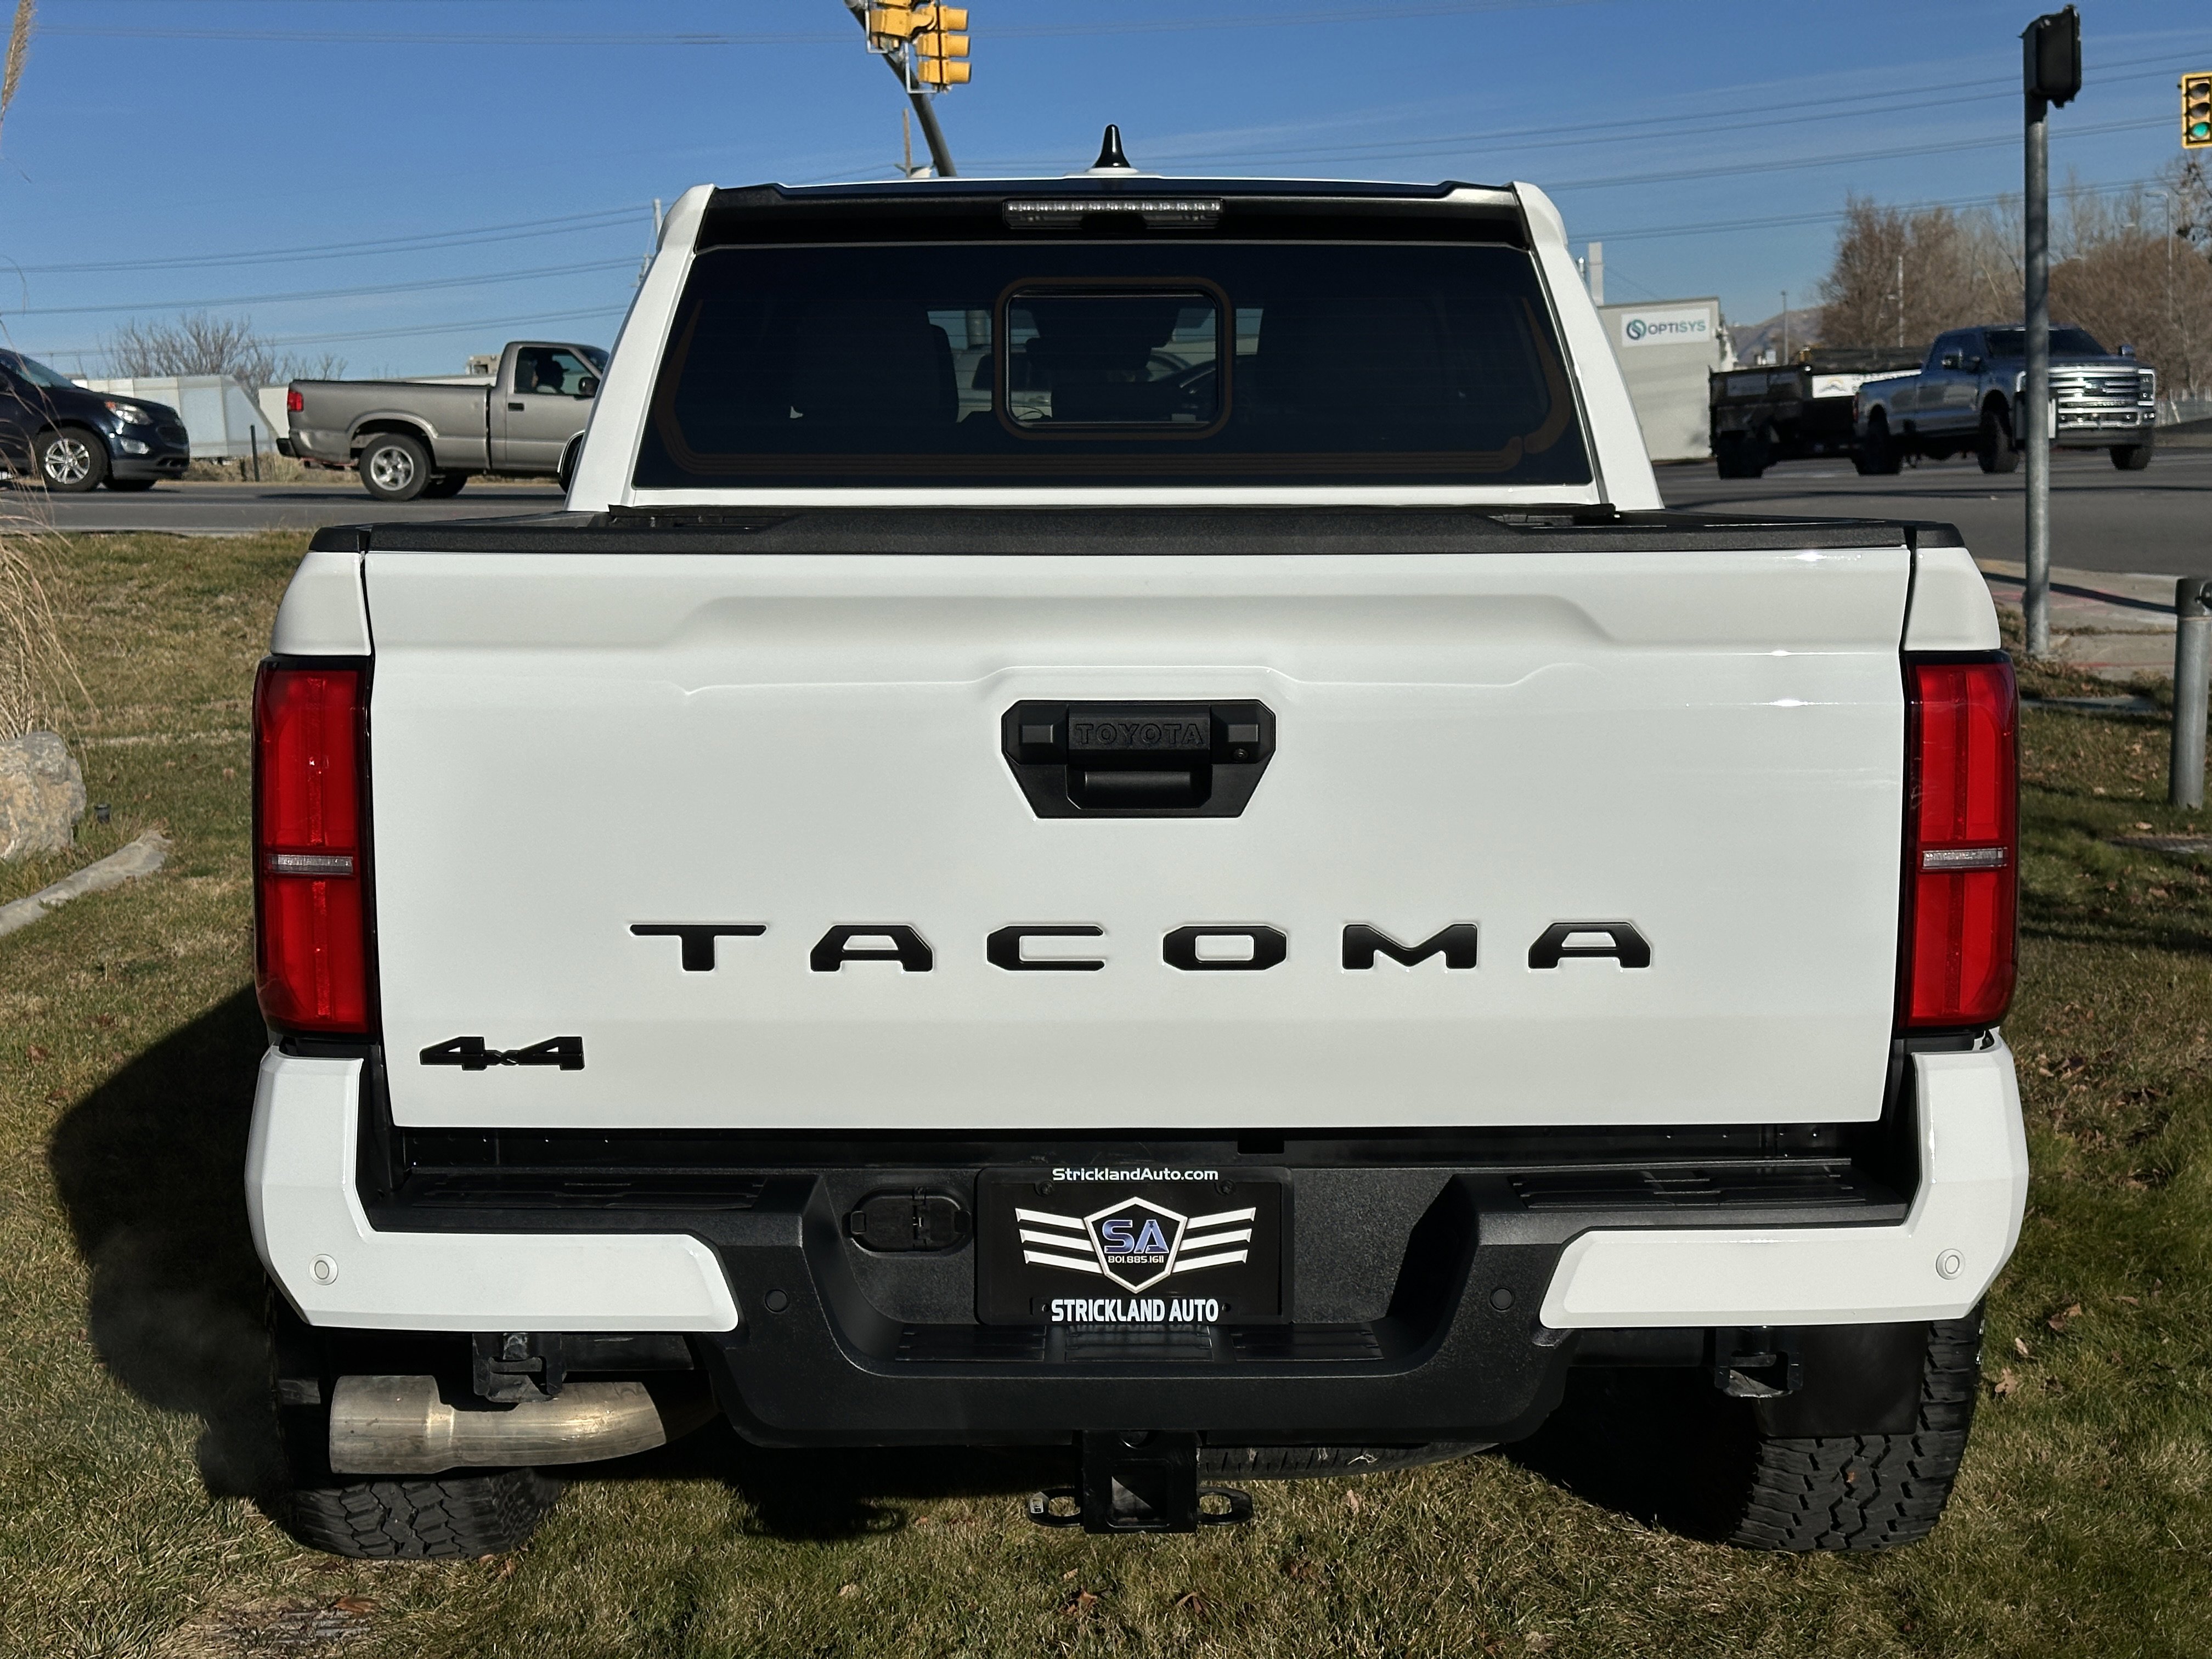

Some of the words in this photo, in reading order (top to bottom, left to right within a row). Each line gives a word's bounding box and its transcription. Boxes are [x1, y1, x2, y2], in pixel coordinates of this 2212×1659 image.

[1648, 319, 1706, 335] OPTISYS
[1075, 723, 1204, 745] TOYOTA
[630, 922, 1651, 972] TACOMA
[1052, 1167, 1218, 1181] StricklandAuto.com
[1102, 1219, 1170, 1254] SA
[1108, 1255, 1164, 1264] 801.885.1611
[1051, 1298, 1165, 1322] STRICKLAND
[1169, 1298, 1219, 1322] AUTO
